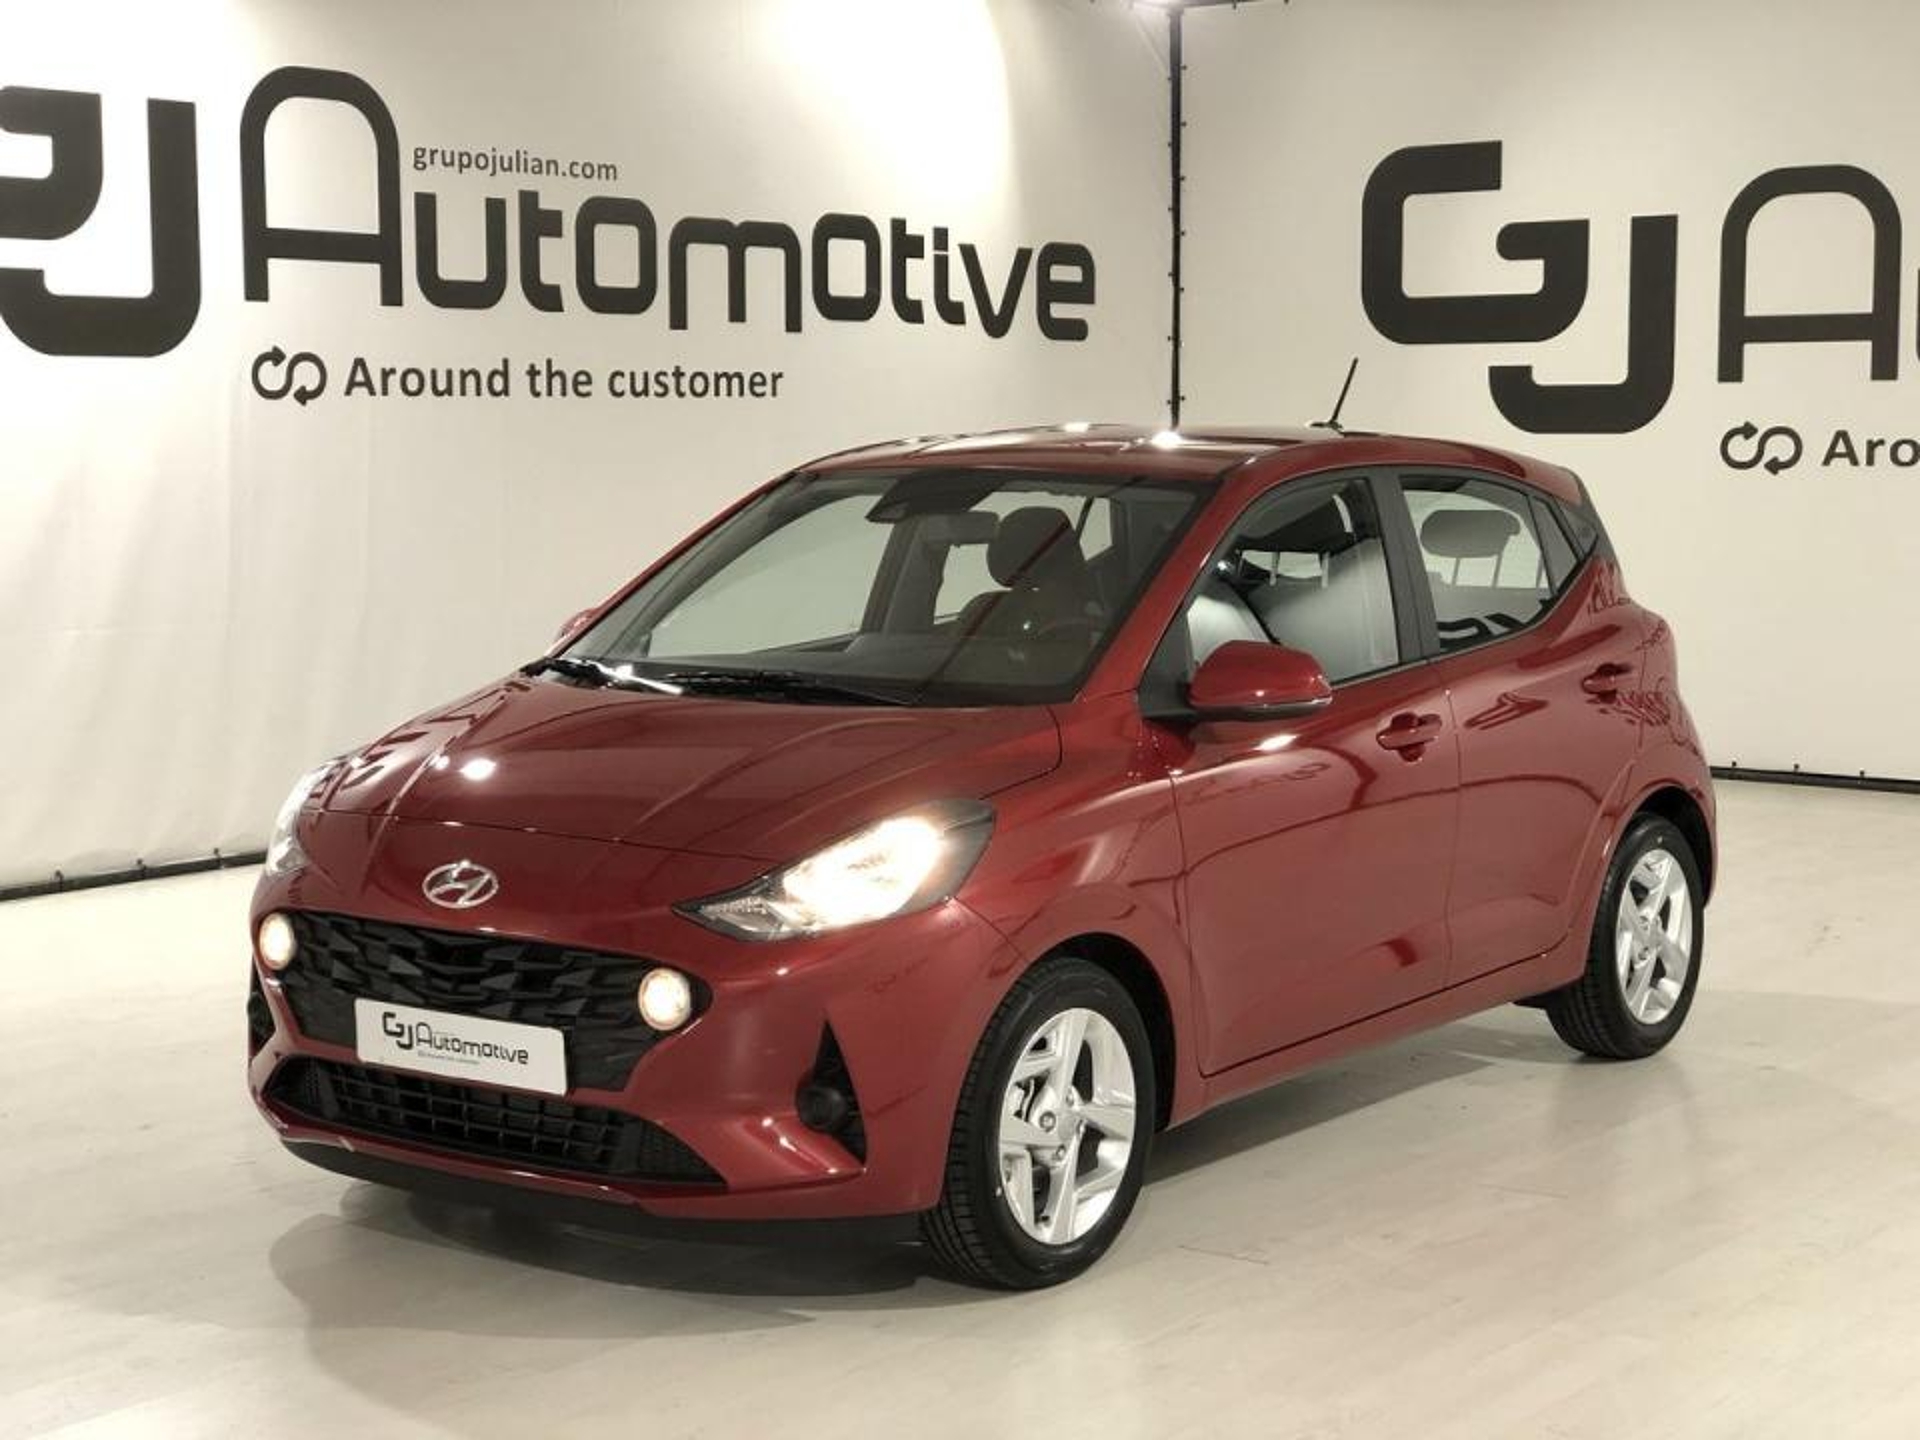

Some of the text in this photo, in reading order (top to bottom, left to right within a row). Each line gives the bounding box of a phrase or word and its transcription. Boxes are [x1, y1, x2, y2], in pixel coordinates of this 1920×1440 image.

[413, 147, 618, 181] grupojulian.com
[240, 66, 1096, 342] Automotive
[1361, 139, 1920, 435] GJ A
[344, 357, 784, 399] Around the customer
[1821, 429, 1920, 467] Aro
[382, 1011, 529, 1065] GJ Automotive
